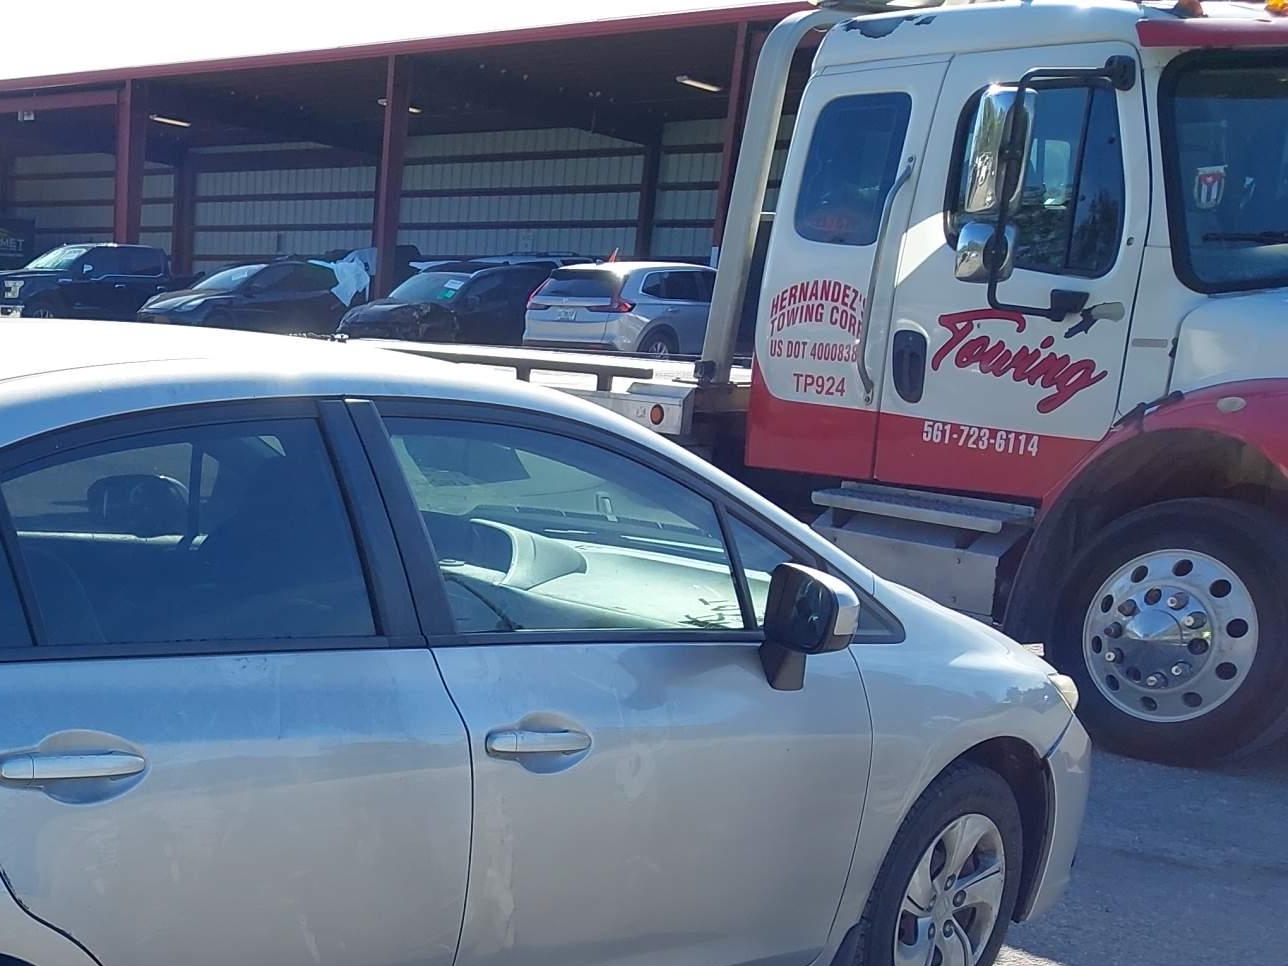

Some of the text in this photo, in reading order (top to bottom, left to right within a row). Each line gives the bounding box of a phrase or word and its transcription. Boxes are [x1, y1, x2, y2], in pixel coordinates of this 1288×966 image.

[770, 303, 825, 337] TOWING
[769, 339, 857, 363] US DOT 4000838
[931, 308, 1108, 414] Towing
[793, 373, 846, 397] TP924
[922, 420, 1040, 457] 561-723-6114
